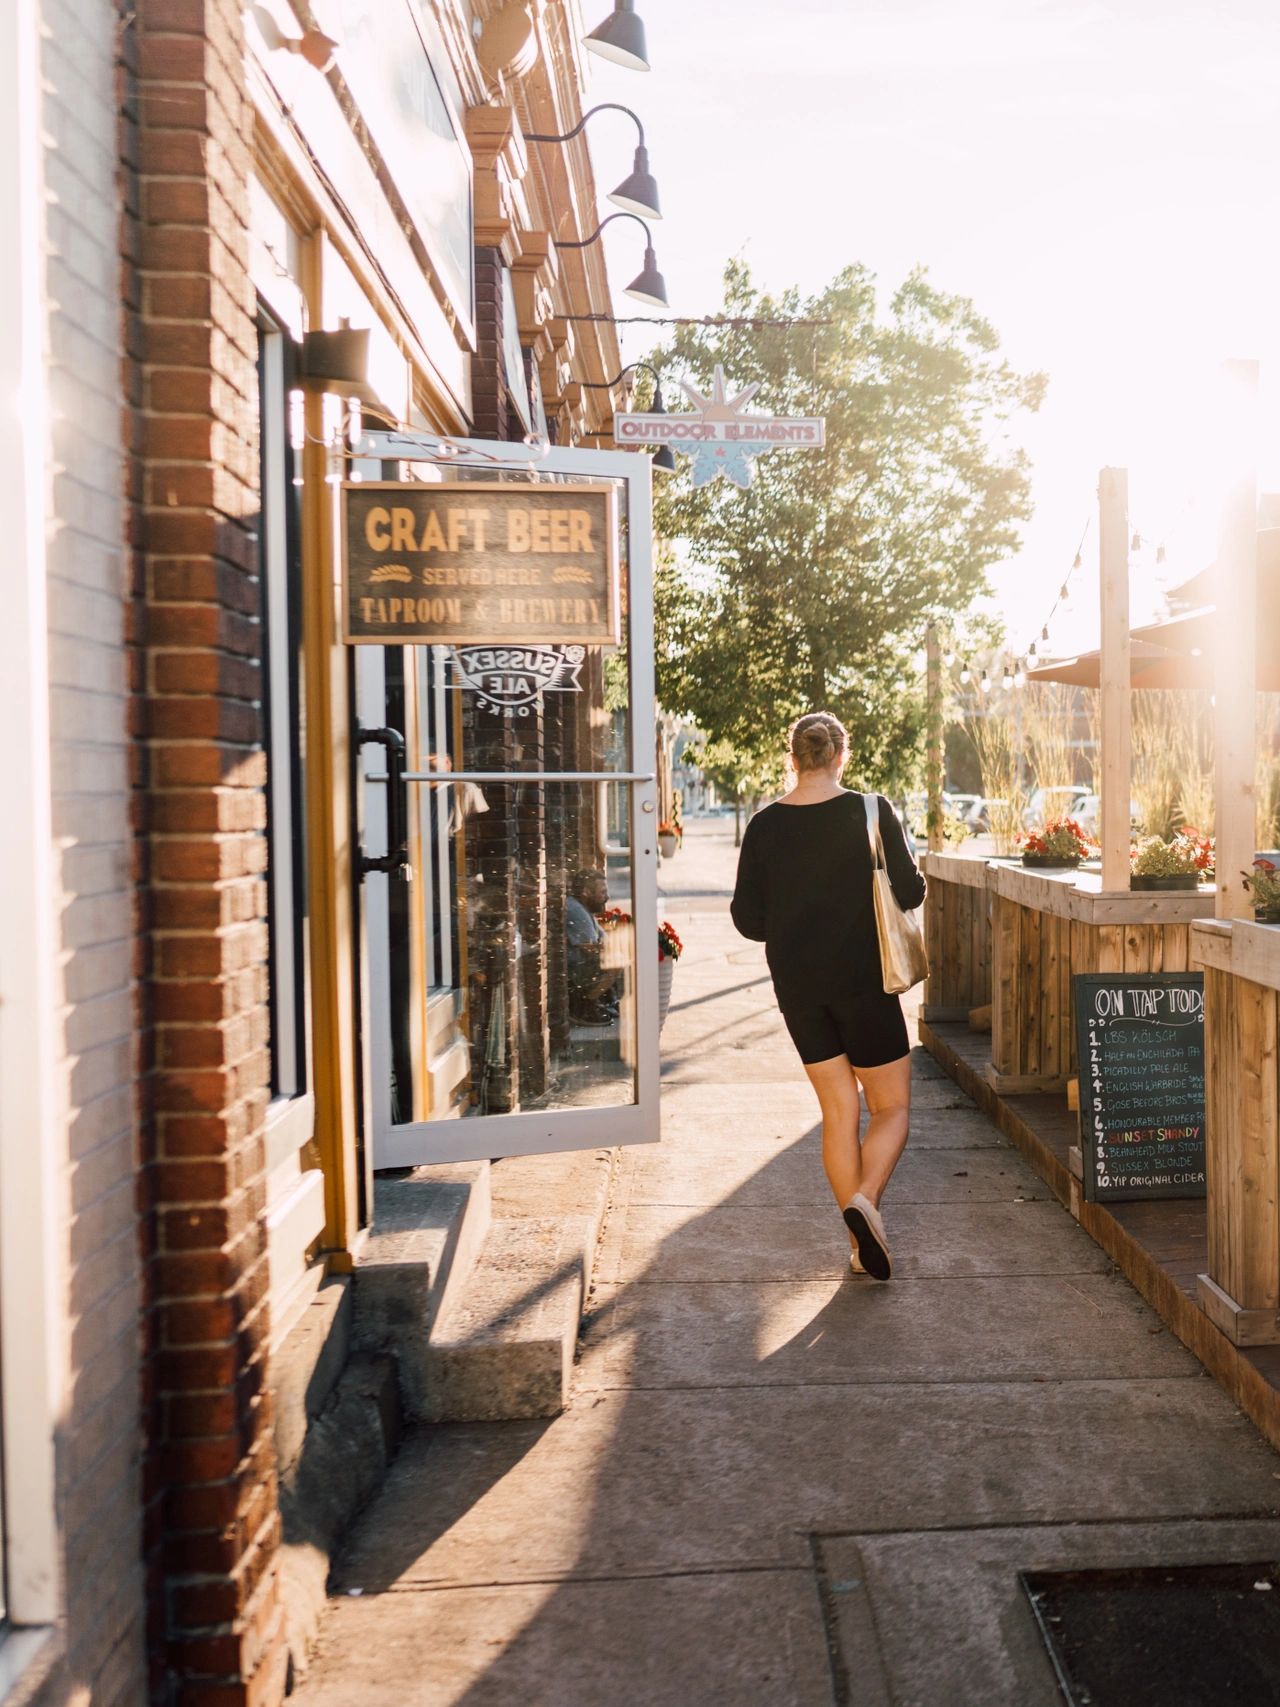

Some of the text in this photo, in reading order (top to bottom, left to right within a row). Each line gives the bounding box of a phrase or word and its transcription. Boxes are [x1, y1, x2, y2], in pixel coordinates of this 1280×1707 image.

[621, 422, 816, 441] OUTDOOR ELEMENTS
[364, 506, 596, 553] CRAFT BEER
[422, 567, 542, 586] SERVED HERE
[360, 597, 601, 625] TAPROOM & BREWERY
[1095, 989, 1124, 1016] ON
[1127, 989, 1164, 1017] TAP
[1089, 1031, 1101, 1046] 1.
[1090, 1049, 1102, 1061] 2.
[1091, 1064, 1102, 1077] 3.
[1173, 1063, 1190, 1073] ALE
[1093, 1079, 1105, 1093] 4.
[1106, 1081, 1143, 1094] ENGLISH
[1093, 1098, 1106, 1112] 5.
[1132, 1096, 1164, 1109] BEFORE
[1094, 1115, 1108, 1130] 6.
[1108, 1117, 1161, 1129] HONOURABLE
[1095, 1127, 1200, 1144] 7. SUNSET SHANDY
[1097, 1146, 1109, 1159] 8.
[1178, 1141, 1204, 1153] STOUT
[1096, 1156, 1193, 1175] 9. SUSSEX BLONDE
[1112, 1175, 1127, 1187] YIP
[1130, 1175, 1172, 1188] ORIGINAL
[1173, 1172, 1205, 1184] CIDER
